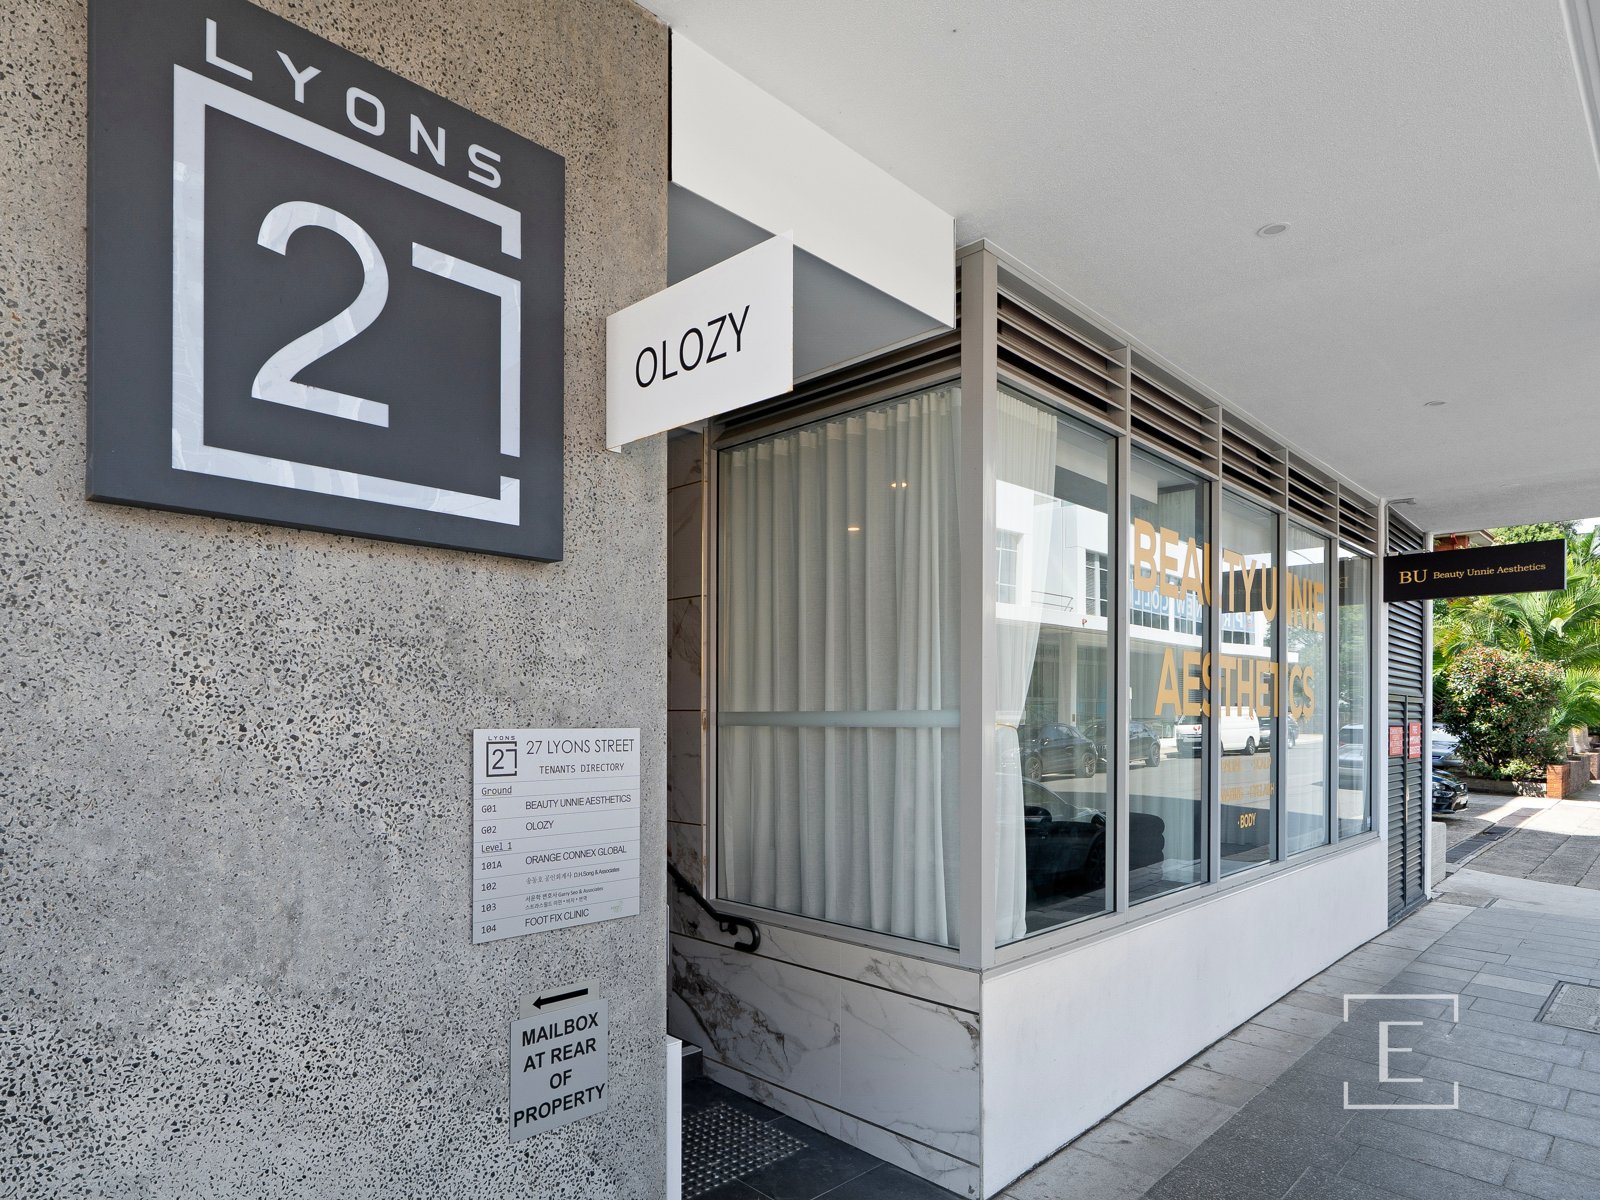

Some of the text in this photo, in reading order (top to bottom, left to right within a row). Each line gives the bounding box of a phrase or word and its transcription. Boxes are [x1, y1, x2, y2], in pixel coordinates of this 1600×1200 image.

[206, 18, 502, 189] LYONS
[635, 304, 750, 388] OLOZY
[1398, 563, 1546, 585] BU Beauty Unnie Aesthetics
[1154, 647, 1315, 721] AESTHETCS
[526, 738, 634, 755] 27 LYONS STREET
[539, 762, 624, 774] TENANTS DIRECTORY
[481, 786, 512, 796] Ground
[481, 804, 496, 814] G01
[526, 794, 632, 810] BEAUTY UNNIE AESTHETICS
[481, 826, 496, 834] G02
[526, 820, 554, 830] OLOZY
[481, 842, 512, 853] Level 1
[526, 846, 627, 865] ORANGE CONNEX GLOBAL
[481, 860, 502, 870] 101A
[481, 882, 496, 892] 102
[481, 904, 496, 913] 103
[525, 908, 590, 927] FOOT FIX CLINIC
[481, 924, 496, 934] 104
[522, 1012, 598, 1047] MAILBOX
[523, 1038, 596, 1072] AT REAR
[550, 1069, 572, 1090] OF
[514, 1083, 606, 1128] PROPERTY
